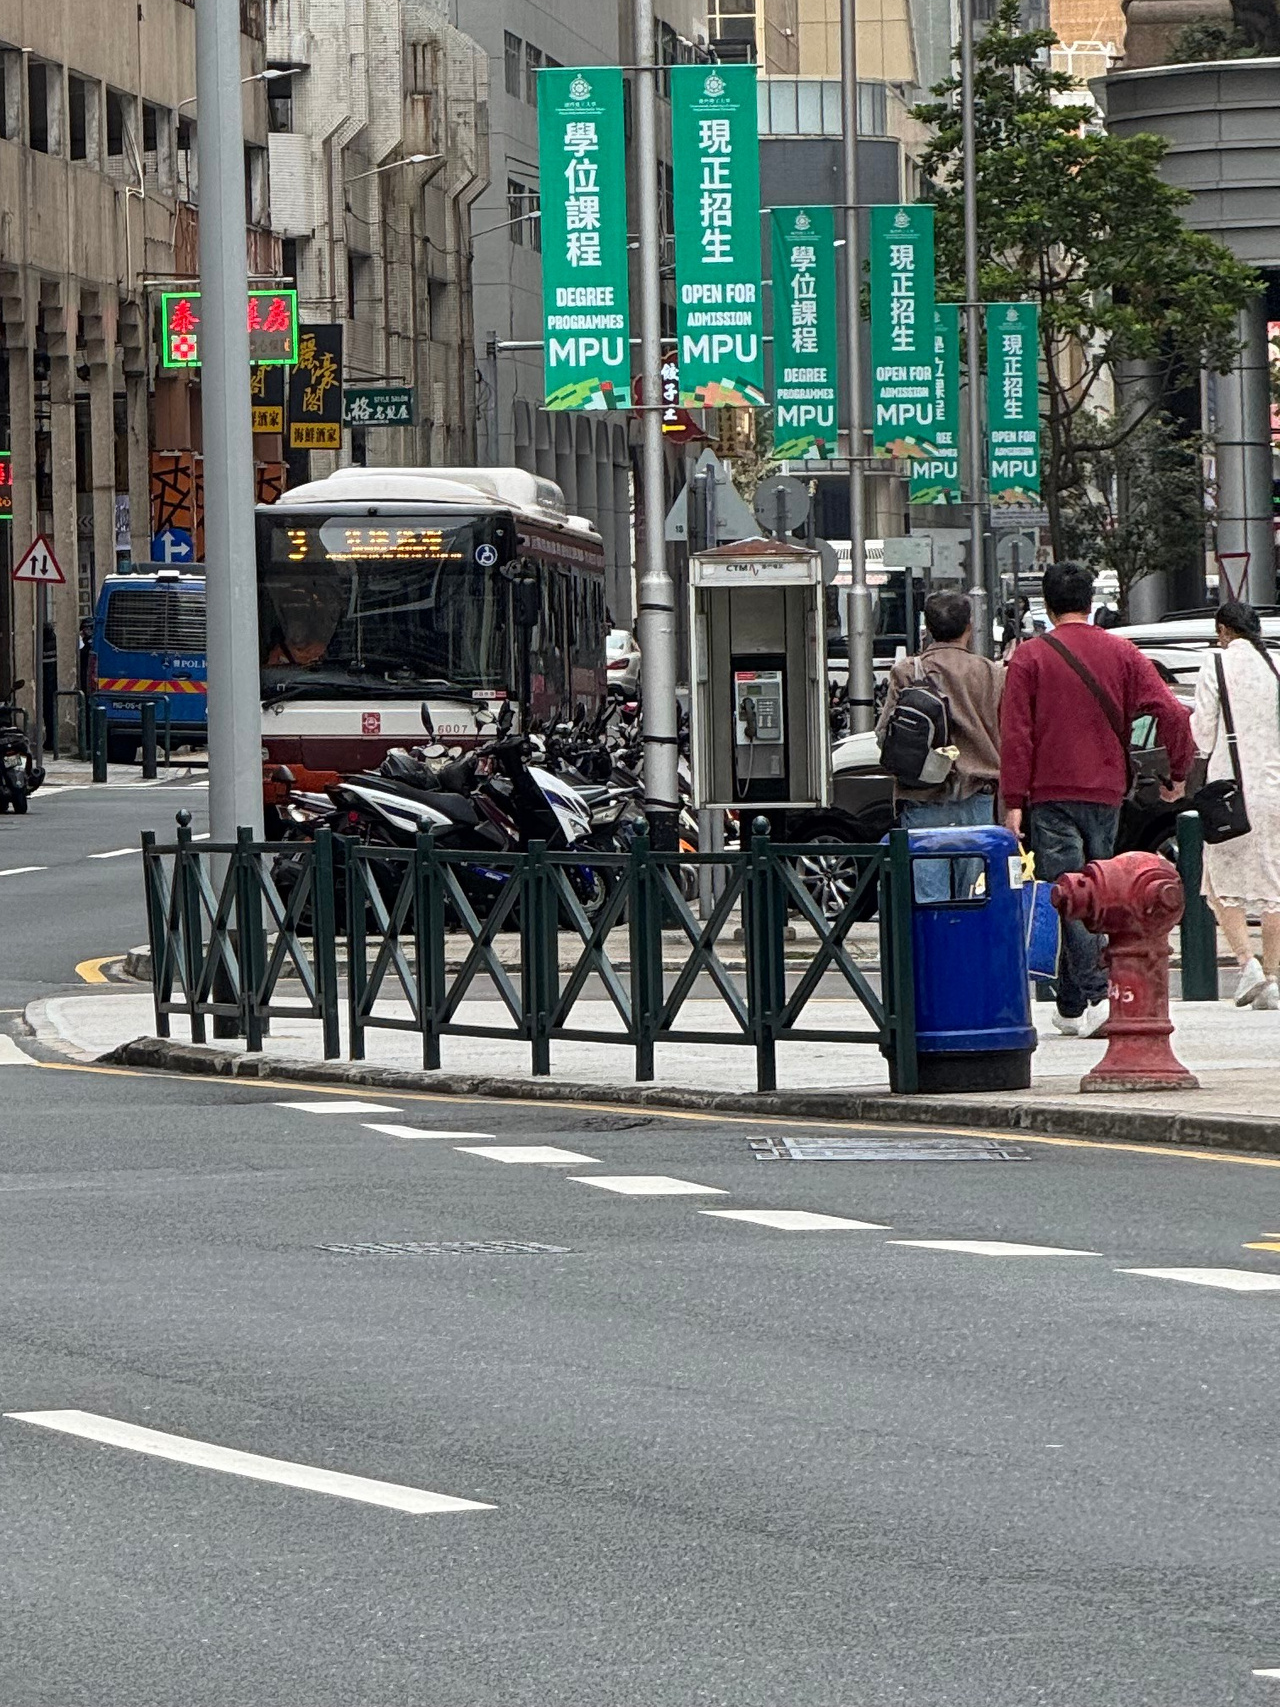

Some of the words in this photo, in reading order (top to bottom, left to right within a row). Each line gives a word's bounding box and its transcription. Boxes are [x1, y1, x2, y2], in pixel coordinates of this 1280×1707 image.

[563, 121, 602, 268] 學位課程
[698, 118, 734, 264] 現正招生
[556, 286, 614, 307] DEGREE
[681, 284, 723, 305] OPEN
[726, 283, 756, 303] FOR
[790, 245, 818, 354] 學位課程
[889, 244, 916, 352] 現正招生
[547, 314, 624, 331] PROGRAMMES
[687, 311, 752, 327] ADMISSION
[549, 337, 624, 367] MPU
[683, 334, 757, 364] MPU
[784, 368, 827, 383] DEGREE
[876, 367, 907, 382] OPEN
[910, 365, 932, 381] FOR
[1002, 334, 1024, 419] 現正招生
[777, 388, 834, 400] PROGRAMMES
[880, 386, 929, 398] ADMISSION
[777, 405, 834, 427] MPU
[876, 403, 933, 426] MPU
[294, 427, 337, 443] 海鮮酒家
[991, 431, 1017, 443] OPEN
[1018, 430, 1036, 443] FOR
[914, 460, 958, 480] MPU
[991, 460, 1037, 479] MPU
[726, 564, 748, 572] CTM
[438, 724, 468, 734] 6007
